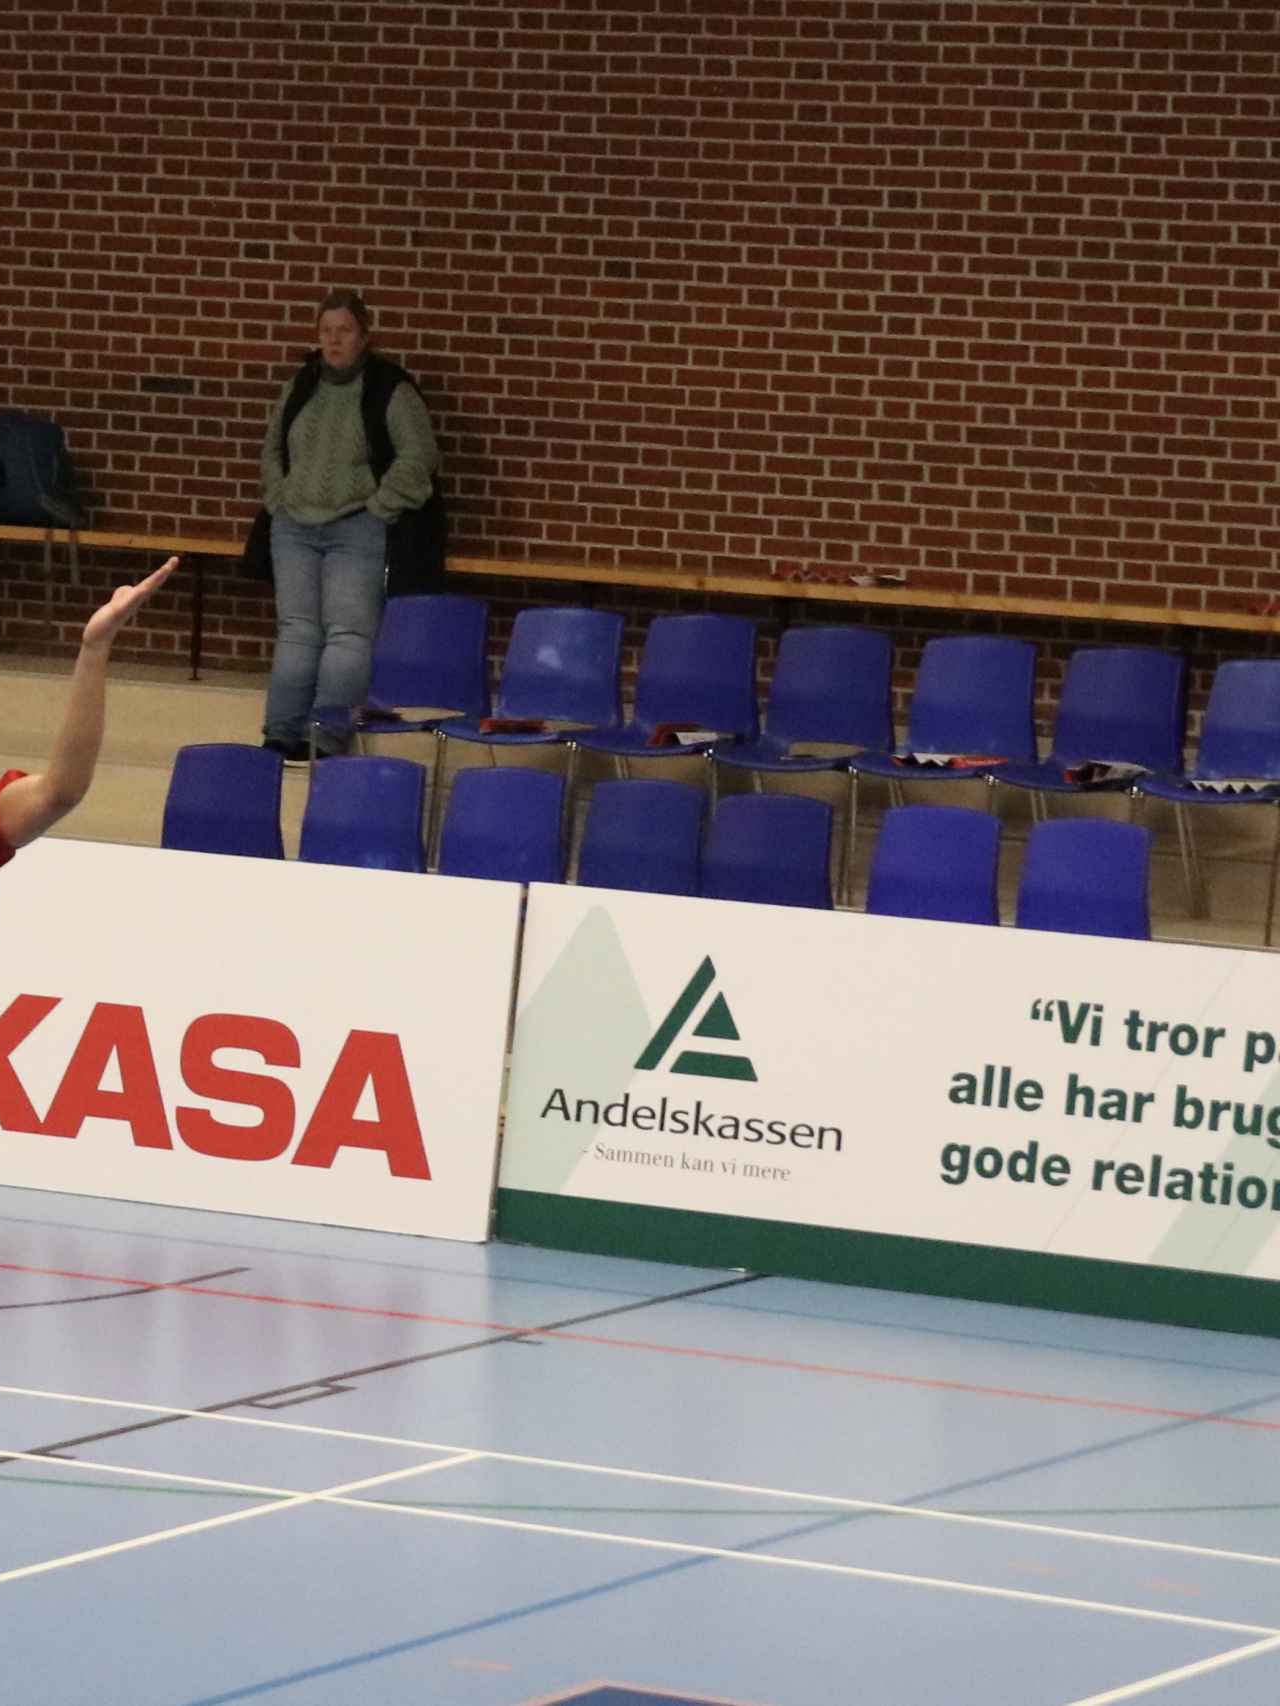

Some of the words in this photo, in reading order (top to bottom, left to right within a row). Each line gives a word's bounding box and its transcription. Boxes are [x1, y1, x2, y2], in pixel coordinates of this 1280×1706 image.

[1124, 1009, 1225, 1058] tror
[1243, 1030, 1280, 1072] p
[540, 1087, 843, 1152] Andelskassen
[948, 1064, 1044, 1112] alle
[1065, 1073, 1155, 1123] har
[593, 1143, 675, 1169] Sammen
[680, 1152, 715, 1174] kan
[720, 1159, 738, 1176] vi
[742, 1164, 791, 1182] mere
[940, 1141, 1071, 1185] gode
[1092, 1154, 1280, 1211] relatio
